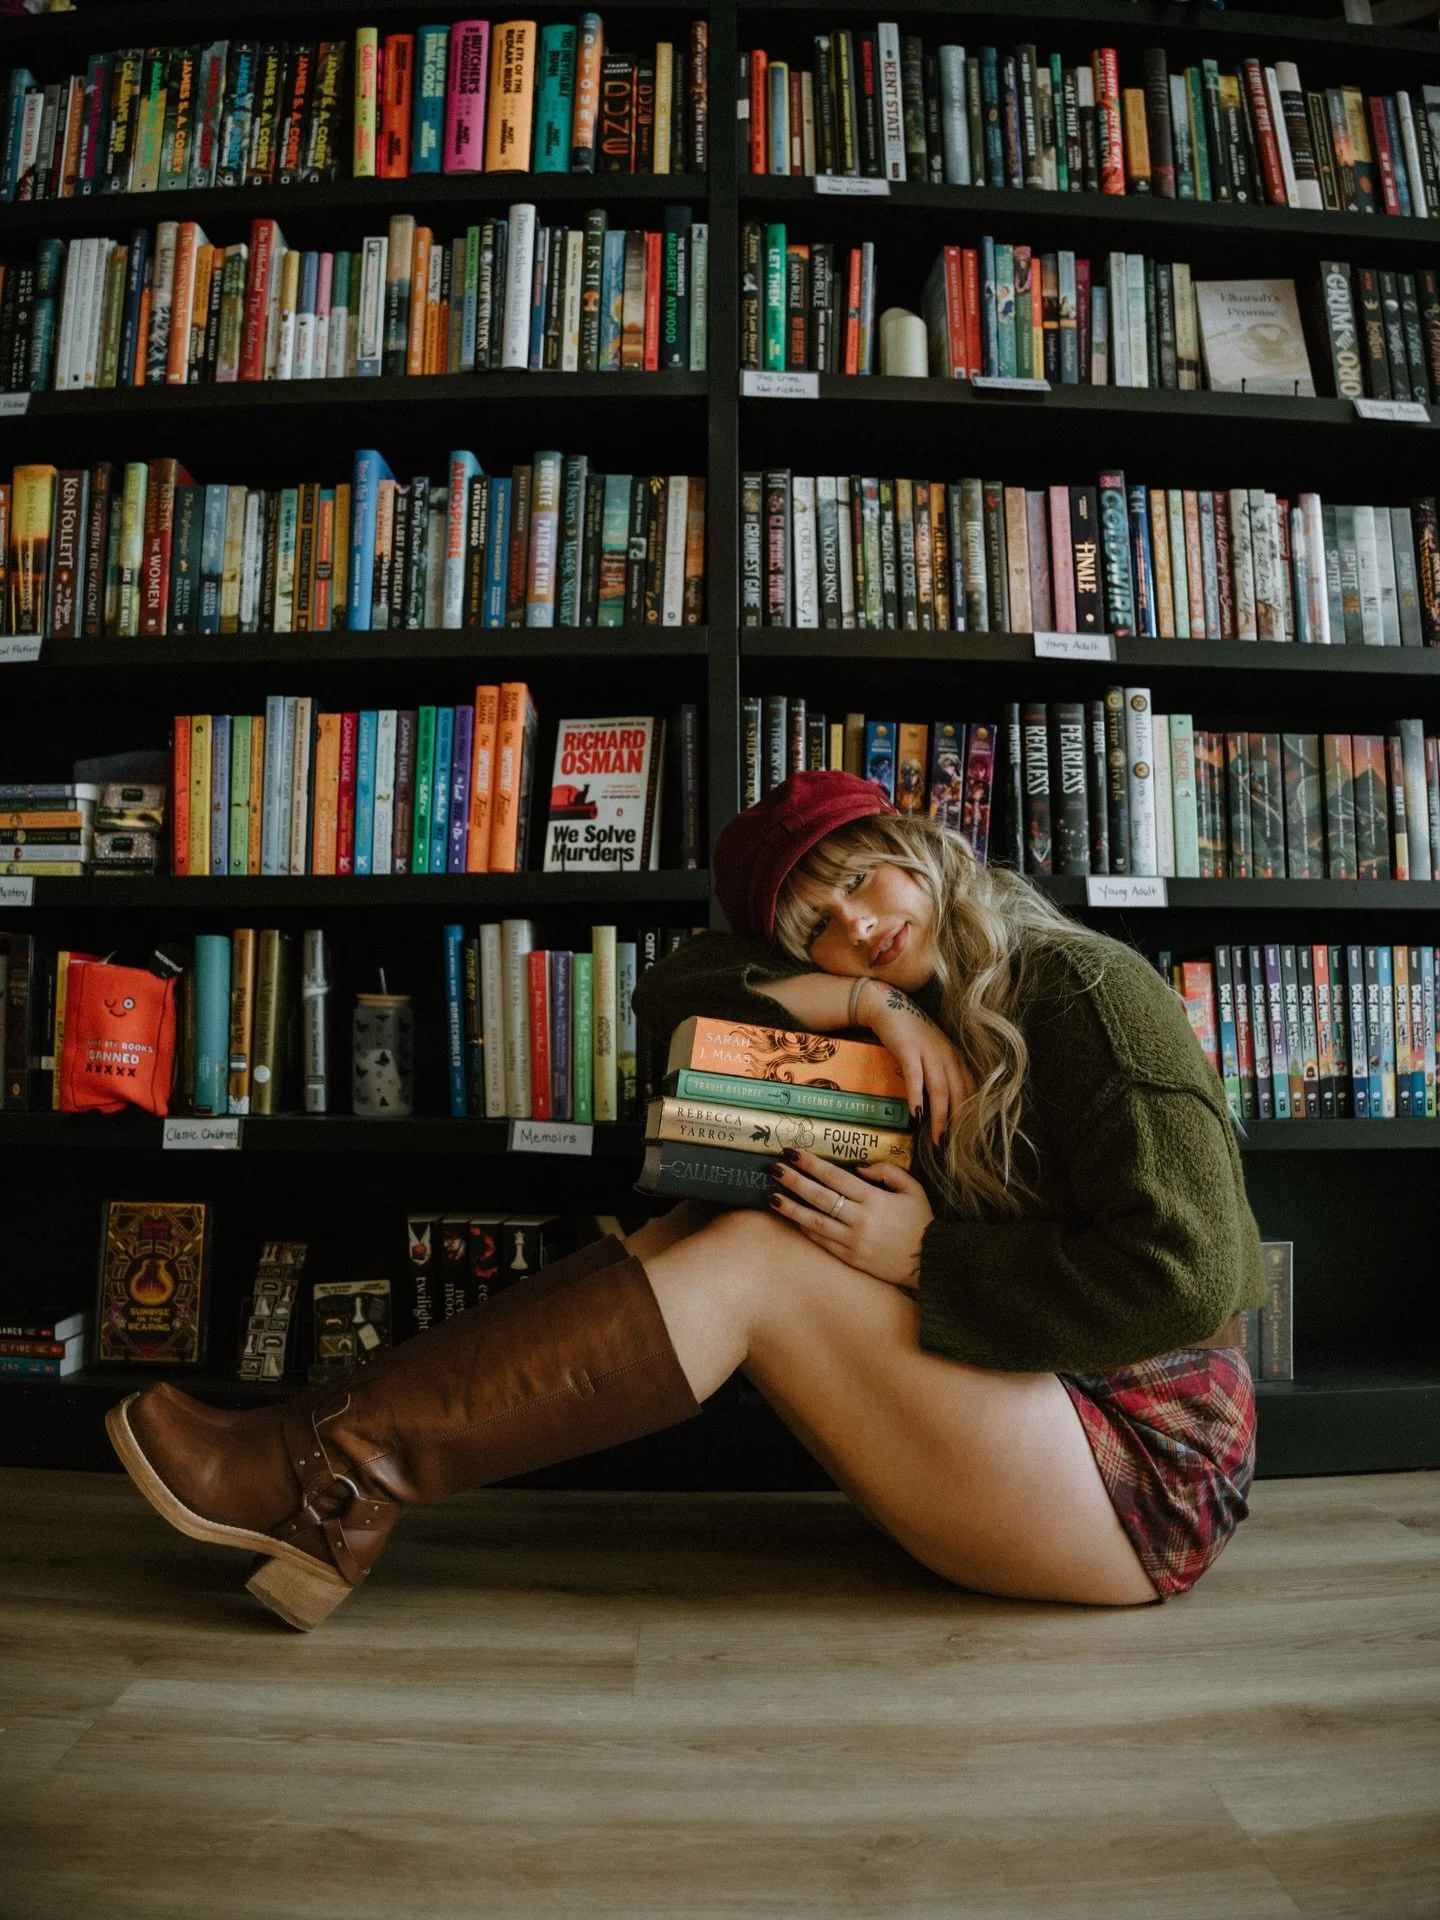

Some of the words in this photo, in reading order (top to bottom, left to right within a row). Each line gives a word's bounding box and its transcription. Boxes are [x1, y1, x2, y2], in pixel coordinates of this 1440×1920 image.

[425, 34, 437, 62] FERAL
[505, 29, 515, 64] BEDLAM
[516, 29, 525, 44] THE
[562, 32, 572, 48] THIS
[458, 35, 470, 94] MASQUERADE
[468, 35, 482, 94] BUTCHER'S
[516, 47, 524, 62] EYE
[548, 51, 559, 76] RUIN
[179, 59, 193, 99] JAMES
[265, 56, 277, 95] JAMES
[296, 56, 309, 95] JAMES
[421, 64, 434, 97] GODS
[503, 68, 513, 93] BRIDE
[515, 65, 523, 76] OF
[559, 50, 571, 97] INEVITABLE
[883, 61, 897, 97] KENT
[1249, 67, 1266, 95] FAMILY
[116, 61, 134, 121] CALIBAN'S
[514, 79, 522, 93] THE
[1065, 85, 1075, 105] ART
[178, 101, 190, 113] S.
[263, 98, 274, 108] S.
[292, 98, 304, 108] S.
[696, 104, 705, 121] IAN
[1254, 96, 1267, 106] OF
[176, 115, 188, 128] A.
[261, 112, 273, 124] A.
[291, 112, 302, 123] A.
[886, 101, 900, 141] STATE
[1066, 107, 1077, 137] THIEF
[1256, 108, 1271, 130] SPIES
[113, 124, 128, 153] WAR
[172, 131, 186, 173] COREY
[256, 127, 271, 170] COREY
[286, 127, 300, 169] COREY
[695, 125, 704, 163] McEWAN
[181, 232, 192, 246] The
[258, 227, 268, 242] Elin
[677, 237, 685, 250] THE
[585, 217, 602, 285] FLESH
[665, 232, 677, 291] MARGARET
[769, 248, 780, 268] LET
[254, 244, 267, 292] Hilderbrand
[676, 252, 685, 296] TESTAMENTS
[790, 263, 800, 282] ANN
[175, 252, 190, 328] Correspondent
[768, 273, 780, 306] THEM
[790, 285, 799, 308] RULE
[1326, 274, 1354, 332] GRIM
[665, 296, 677, 343] ATWOOD
[539, 460, 554, 506] BUCKEYE
[567, 461, 579, 478] The
[63, 478, 78, 506] KEN
[414, 483, 425, 498] The
[472, 484, 481, 517] EVELYN
[566, 481, 579, 523] Listeners
[412, 501, 423, 525] Berry
[448, 460, 464, 558] ATMOSPHERE
[58, 510, 76, 568] FOLLETT
[152, 538, 160, 552] THE
[396, 524, 404, 546] LOST
[412, 528, 424, 560] Pickers
[471, 519, 480, 546] HUGO
[536, 520, 551, 564] PATRICK
[882, 525, 893, 560] DEATH
[744, 523, 760, 577] GRANDEST
[823, 525, 835, 571] WICKED
[1101, 489, 1131, 627] COLDWIRE
[393, 550, 403, 609] APOTHECARY
[534, 567, 549, 595] RYAN
[883, 562, 895, 593] CURE
[1075, 541, 1097, 593] FINALE
[148, 555, 161, 608] WOMEN
[744, 579, 760, 607] GAME
[823, 573, 837, 603] KING
[174, 578, 183, 615] HANNAH
[182, 579, 190, 614] KRISTIN
[1044, 638, 1068, 652] Young
[1072, 639, 1099, 650] Adult
[342, 716, 352, 754] JOANNE
[401, 717, 410, 755] JOANNE
[341, 756, 351, 782] FLUKE
[399, 757, 408, 783] FLUKE
[561, 750, 643, 775] OSMAN
[1025, 726, 1049, 795] RECKLESS
[1060, 724, 1085, 794] FEARLESS
[554, 826, 579, 843] We
[584, 825, 636, 843] Solve
[551, 844, 634, 862] Murders
[1098, 886, 1127, 902] Young
[1130, 886, 1157, 897] Adult
[121, 1043, 153, 1053] BOOKS
[449, 1001, 461, 1067] HOMESCHOOLED
[706, 1032, 751, 1048] SARAH
[89, 1049, 140, 1064] BANNED
[700, 1048, 708, 1059] J.
[712, 1049, 751, 1063] MAAS
[694, 1080, 725, 1094] TRAVIS
[727, 1085, 763, 1098] BALDREE
[677, 1106, 743, 1126] REBECCA
[798, 1094, 833, 1108] LEGENDS
[835, 1101, 842, 1109] &
[844, 1102, 876, 1113] LATTES
[521, 1129, 577, 1144] Memoirs
[680, 1125, 736, 1143] YARROS
[823, 1128, 879, 1149] FOURTH
[831, 1143, 869, 1161] WING
[729, 1168, 769, 1191] HART
[413, 1276, 432, 1331] twilight
